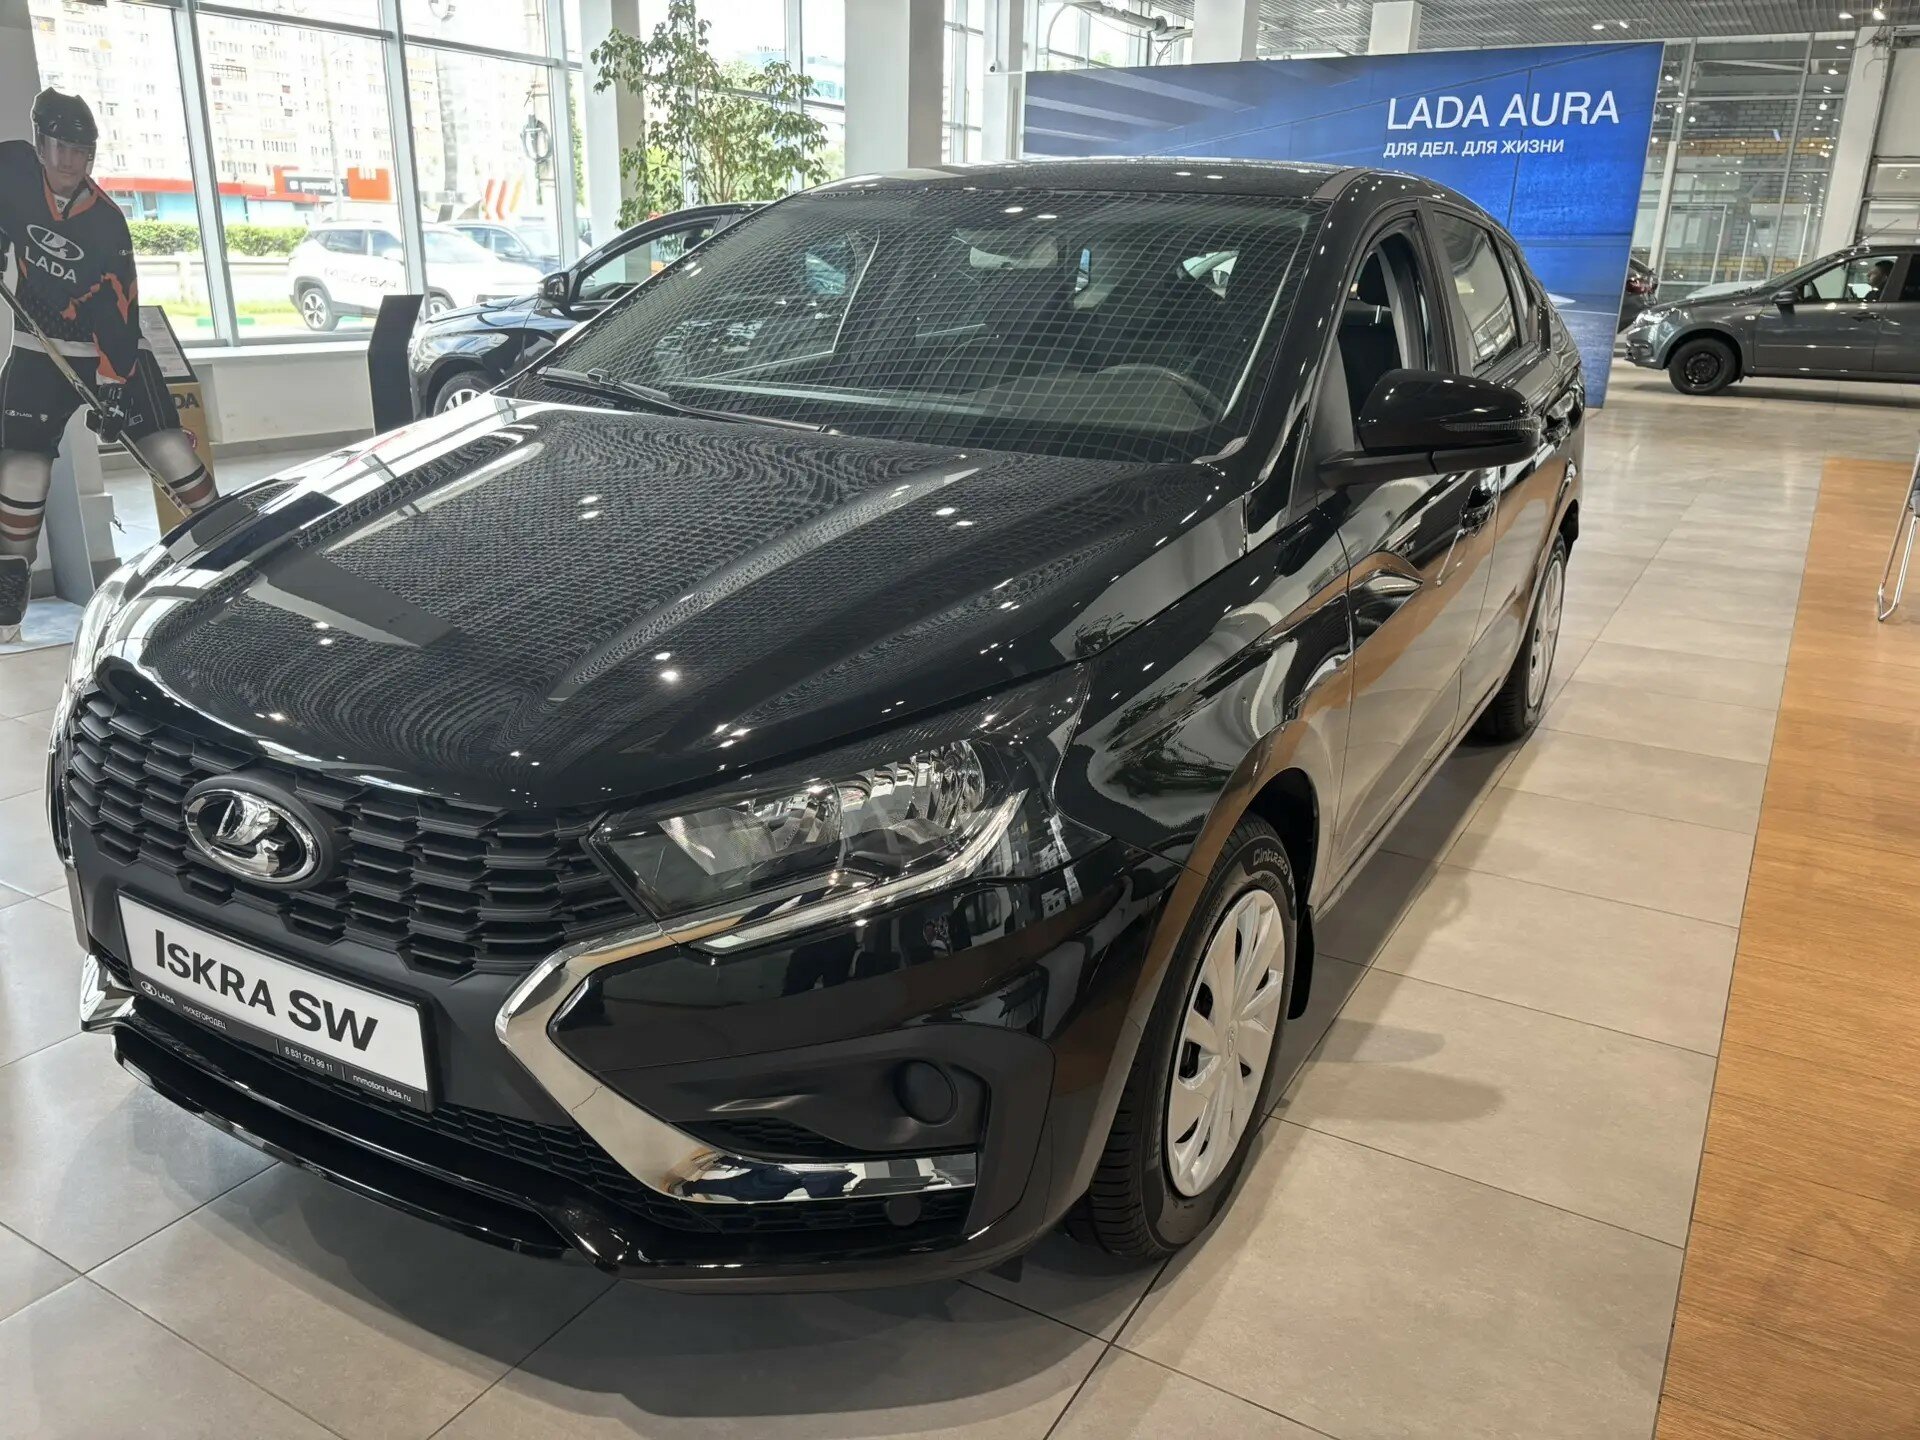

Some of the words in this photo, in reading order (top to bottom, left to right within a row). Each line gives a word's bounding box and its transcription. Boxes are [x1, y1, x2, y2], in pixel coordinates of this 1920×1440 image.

[1387, 94, 1490, 130] LADA
[1499, 90, 1620, 127] AURA
[1383, 142, 1417, 158] ДЛЯ
[1419, 141, 1458, 158] ДЕЛ.
[1461, 140, 1497, 157] ДЛЯ
[1500, 138, 1565, 154] ЖИЗНИ
[25, 245, 77, 283] LADA
[170, 392, 200, 409] DA
[157, 990, 176, 1006] LADA
[182, 1004, 227, 1030] НИЖЕГОРОДЕЦ
[287, 989, 379, 1051] SW
[290, 1048, 301, 1060] 831
[303, 1053, 316, 1066] 275
[316, 1059, 325, 1069] 99
[326, 1063, 333, 1072] 11
[352, 1074, 412, 1103] nnmotors.lada.ru
